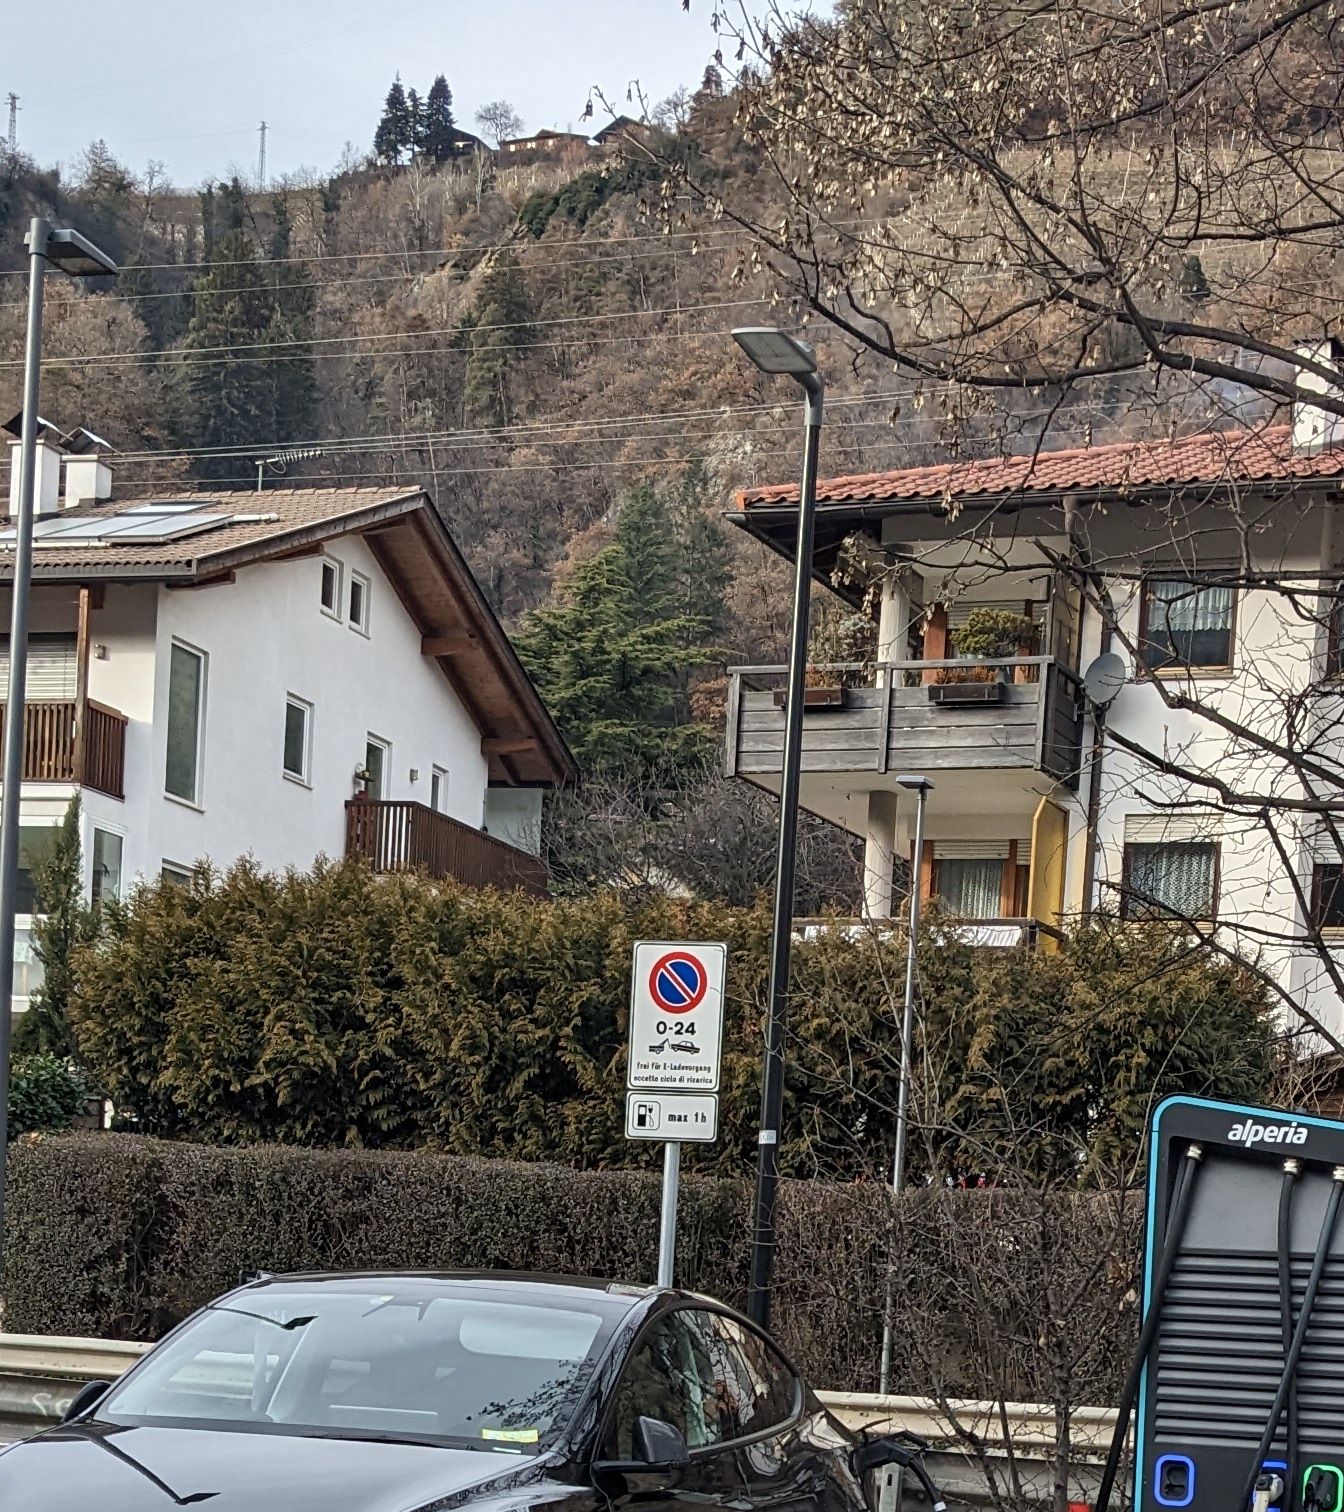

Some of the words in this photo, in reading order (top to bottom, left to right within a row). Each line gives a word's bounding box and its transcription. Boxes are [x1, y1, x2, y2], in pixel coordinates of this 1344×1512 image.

[656, 1020, 697, 1036] 0-24
[637, 1062, 650, 1070] frei
[634, 1075, 659, 1083] eccetto
[668, 1114, 688, 1123] max
[1228, 1119, 1308, 1147] alperia
